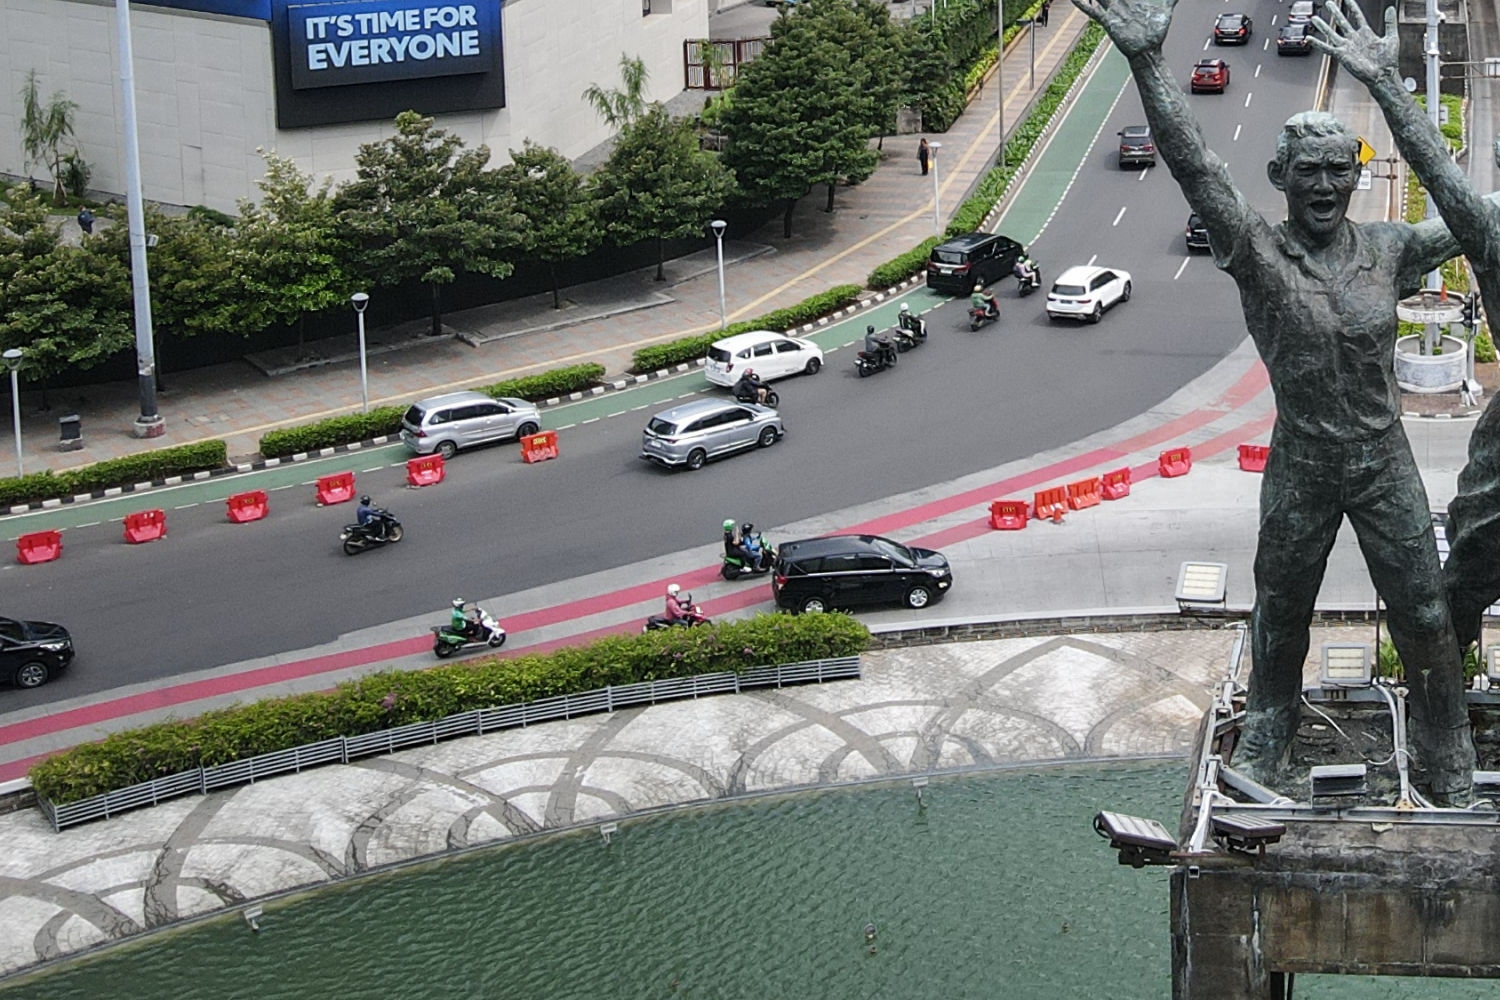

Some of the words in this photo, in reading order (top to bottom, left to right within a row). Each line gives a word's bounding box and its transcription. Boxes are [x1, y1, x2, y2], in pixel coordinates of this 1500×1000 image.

[305, 14, 354, 40] IT'S
[355, 8, 421, 35] TIME
[423, 5, 478, 29] FOR
[307, 30, 480, 71] EVERYONE
